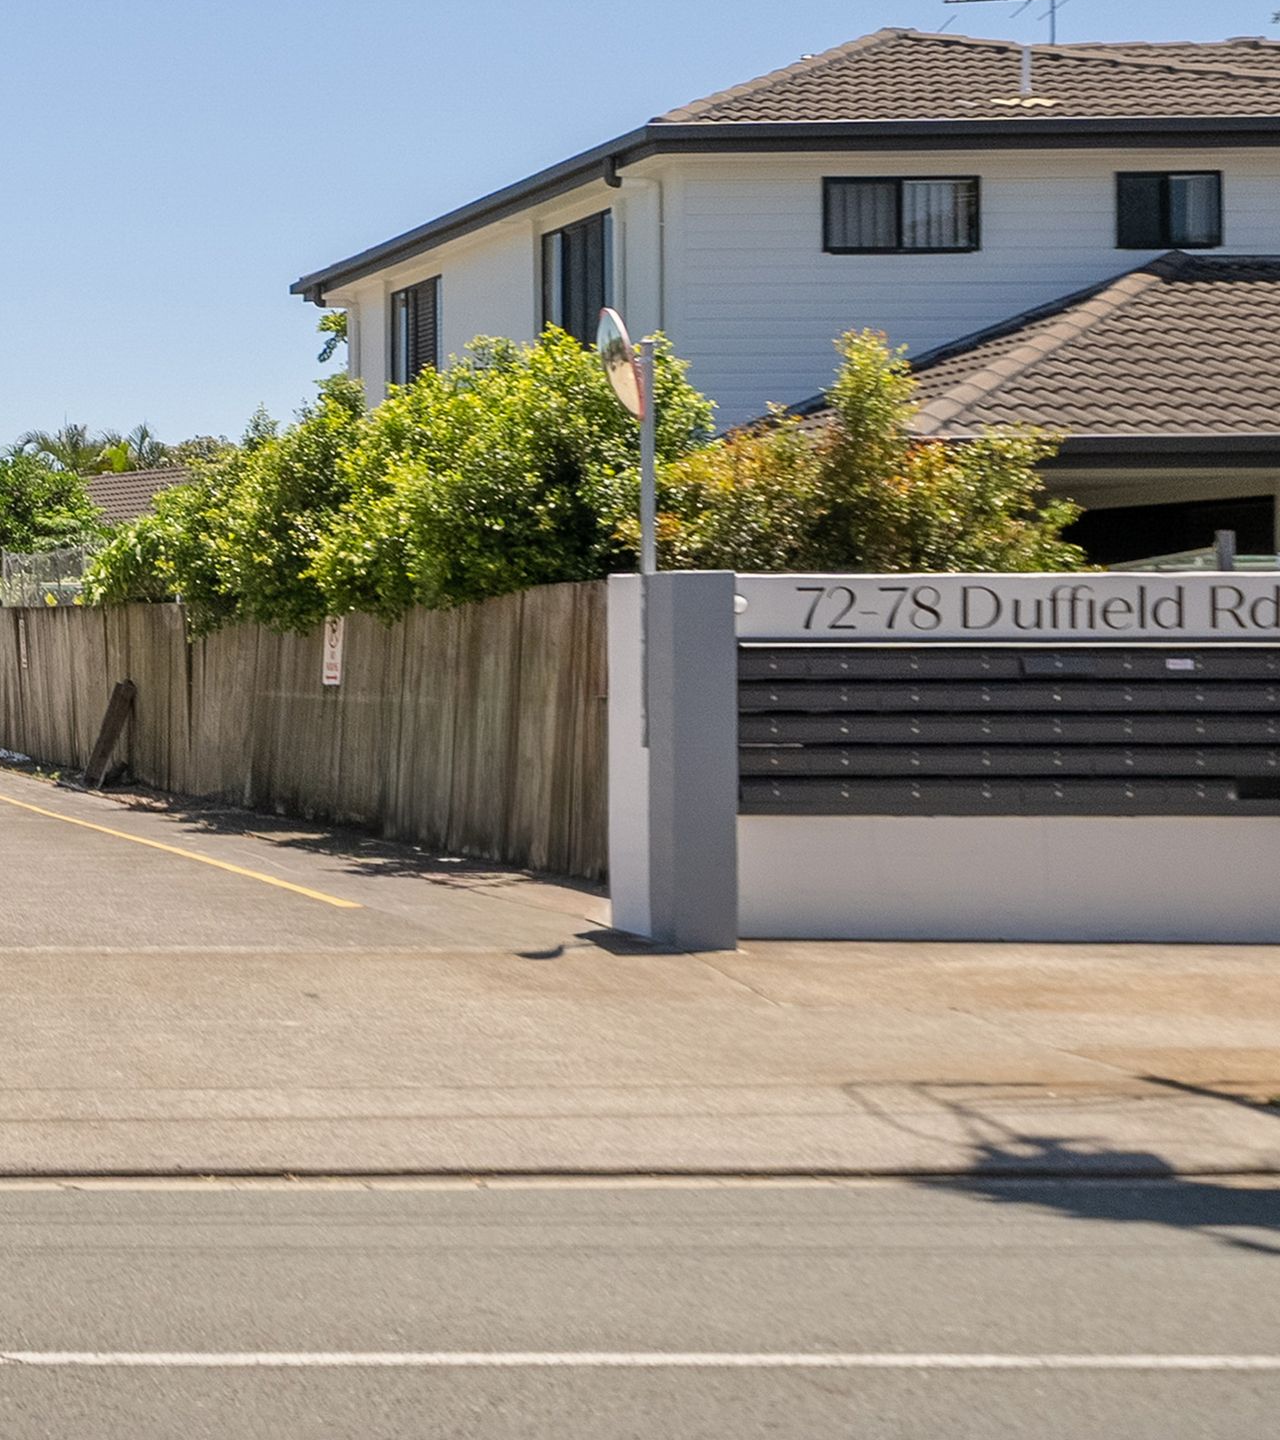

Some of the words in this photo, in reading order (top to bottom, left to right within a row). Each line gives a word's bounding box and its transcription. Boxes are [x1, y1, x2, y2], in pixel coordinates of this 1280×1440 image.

[794, 585, 943, 631] 72-78
[960, 583, 1186, 631] Duffield
[1208, 583, 1280, 630] Rd
